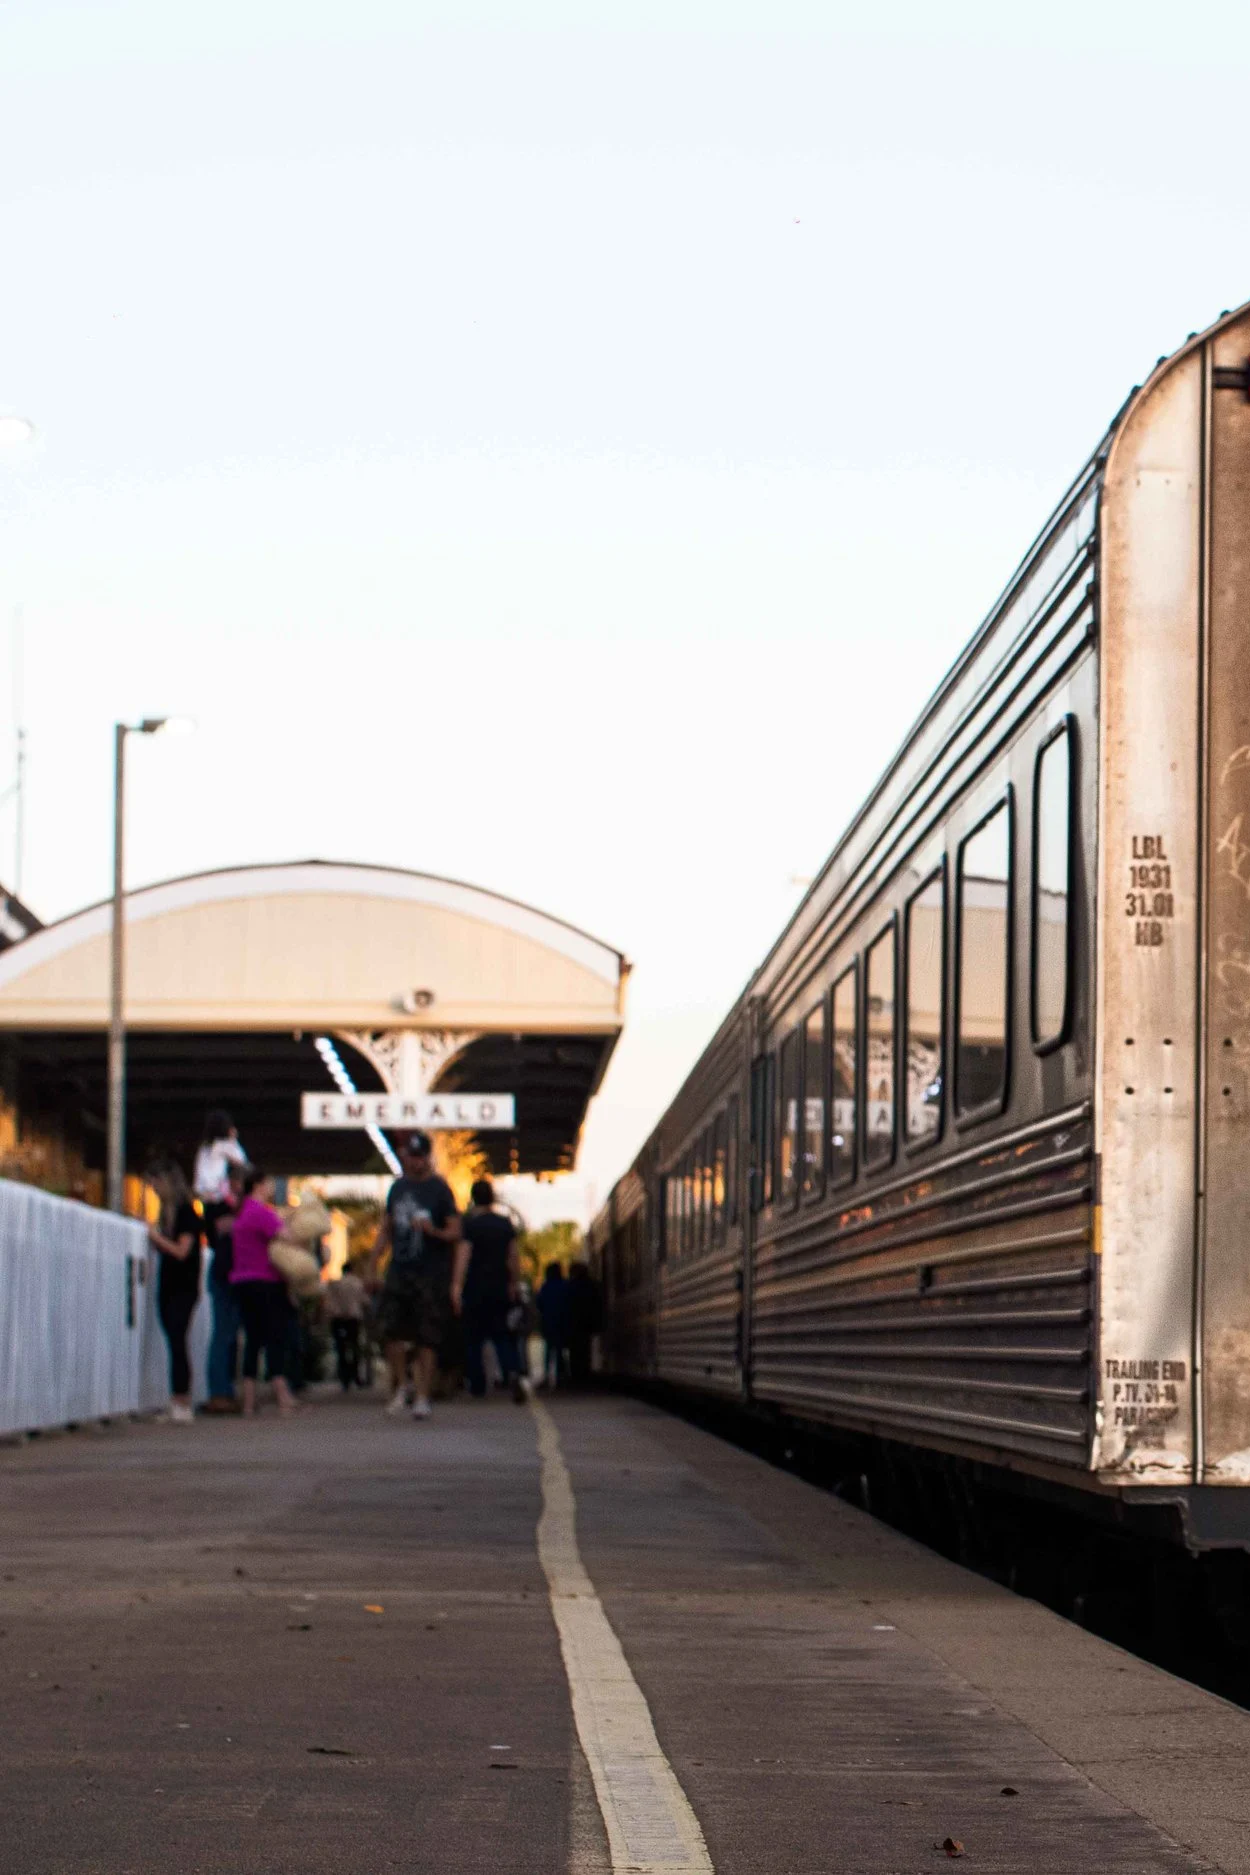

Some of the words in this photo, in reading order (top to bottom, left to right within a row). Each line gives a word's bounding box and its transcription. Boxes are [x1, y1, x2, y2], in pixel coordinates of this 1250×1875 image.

[1132, 835, 1167, 860] LBL
[1129, 864, 1171, 889] 1931
[1135, 921, 1164, 946] HB
[319, 1102, 497, 1120] EMERALD
[1105, 1359, 1160, 1380] TRAILING
